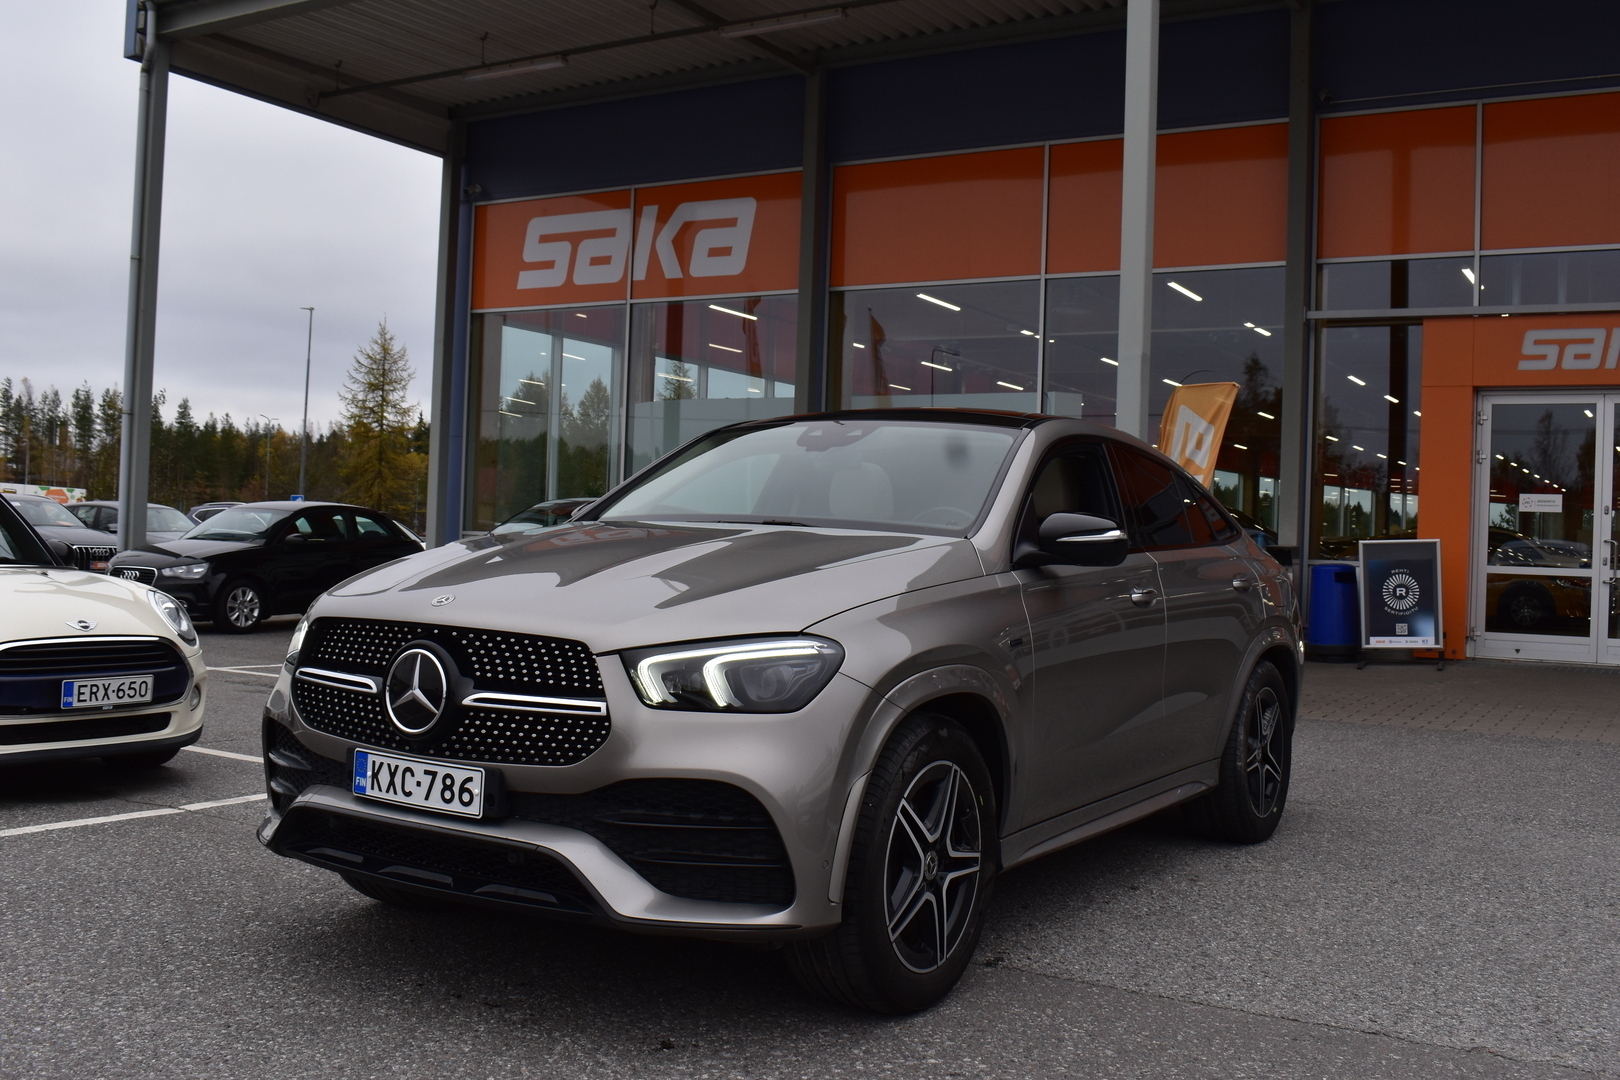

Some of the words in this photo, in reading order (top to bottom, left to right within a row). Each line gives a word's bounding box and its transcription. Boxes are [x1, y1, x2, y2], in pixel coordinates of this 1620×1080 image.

[1396, 587, 1406, 596] R
[77, 680, 148, 703] ERX-650
[355, 776, 367, 787] FIN
[371, 760, 474, 807] KXC-786
